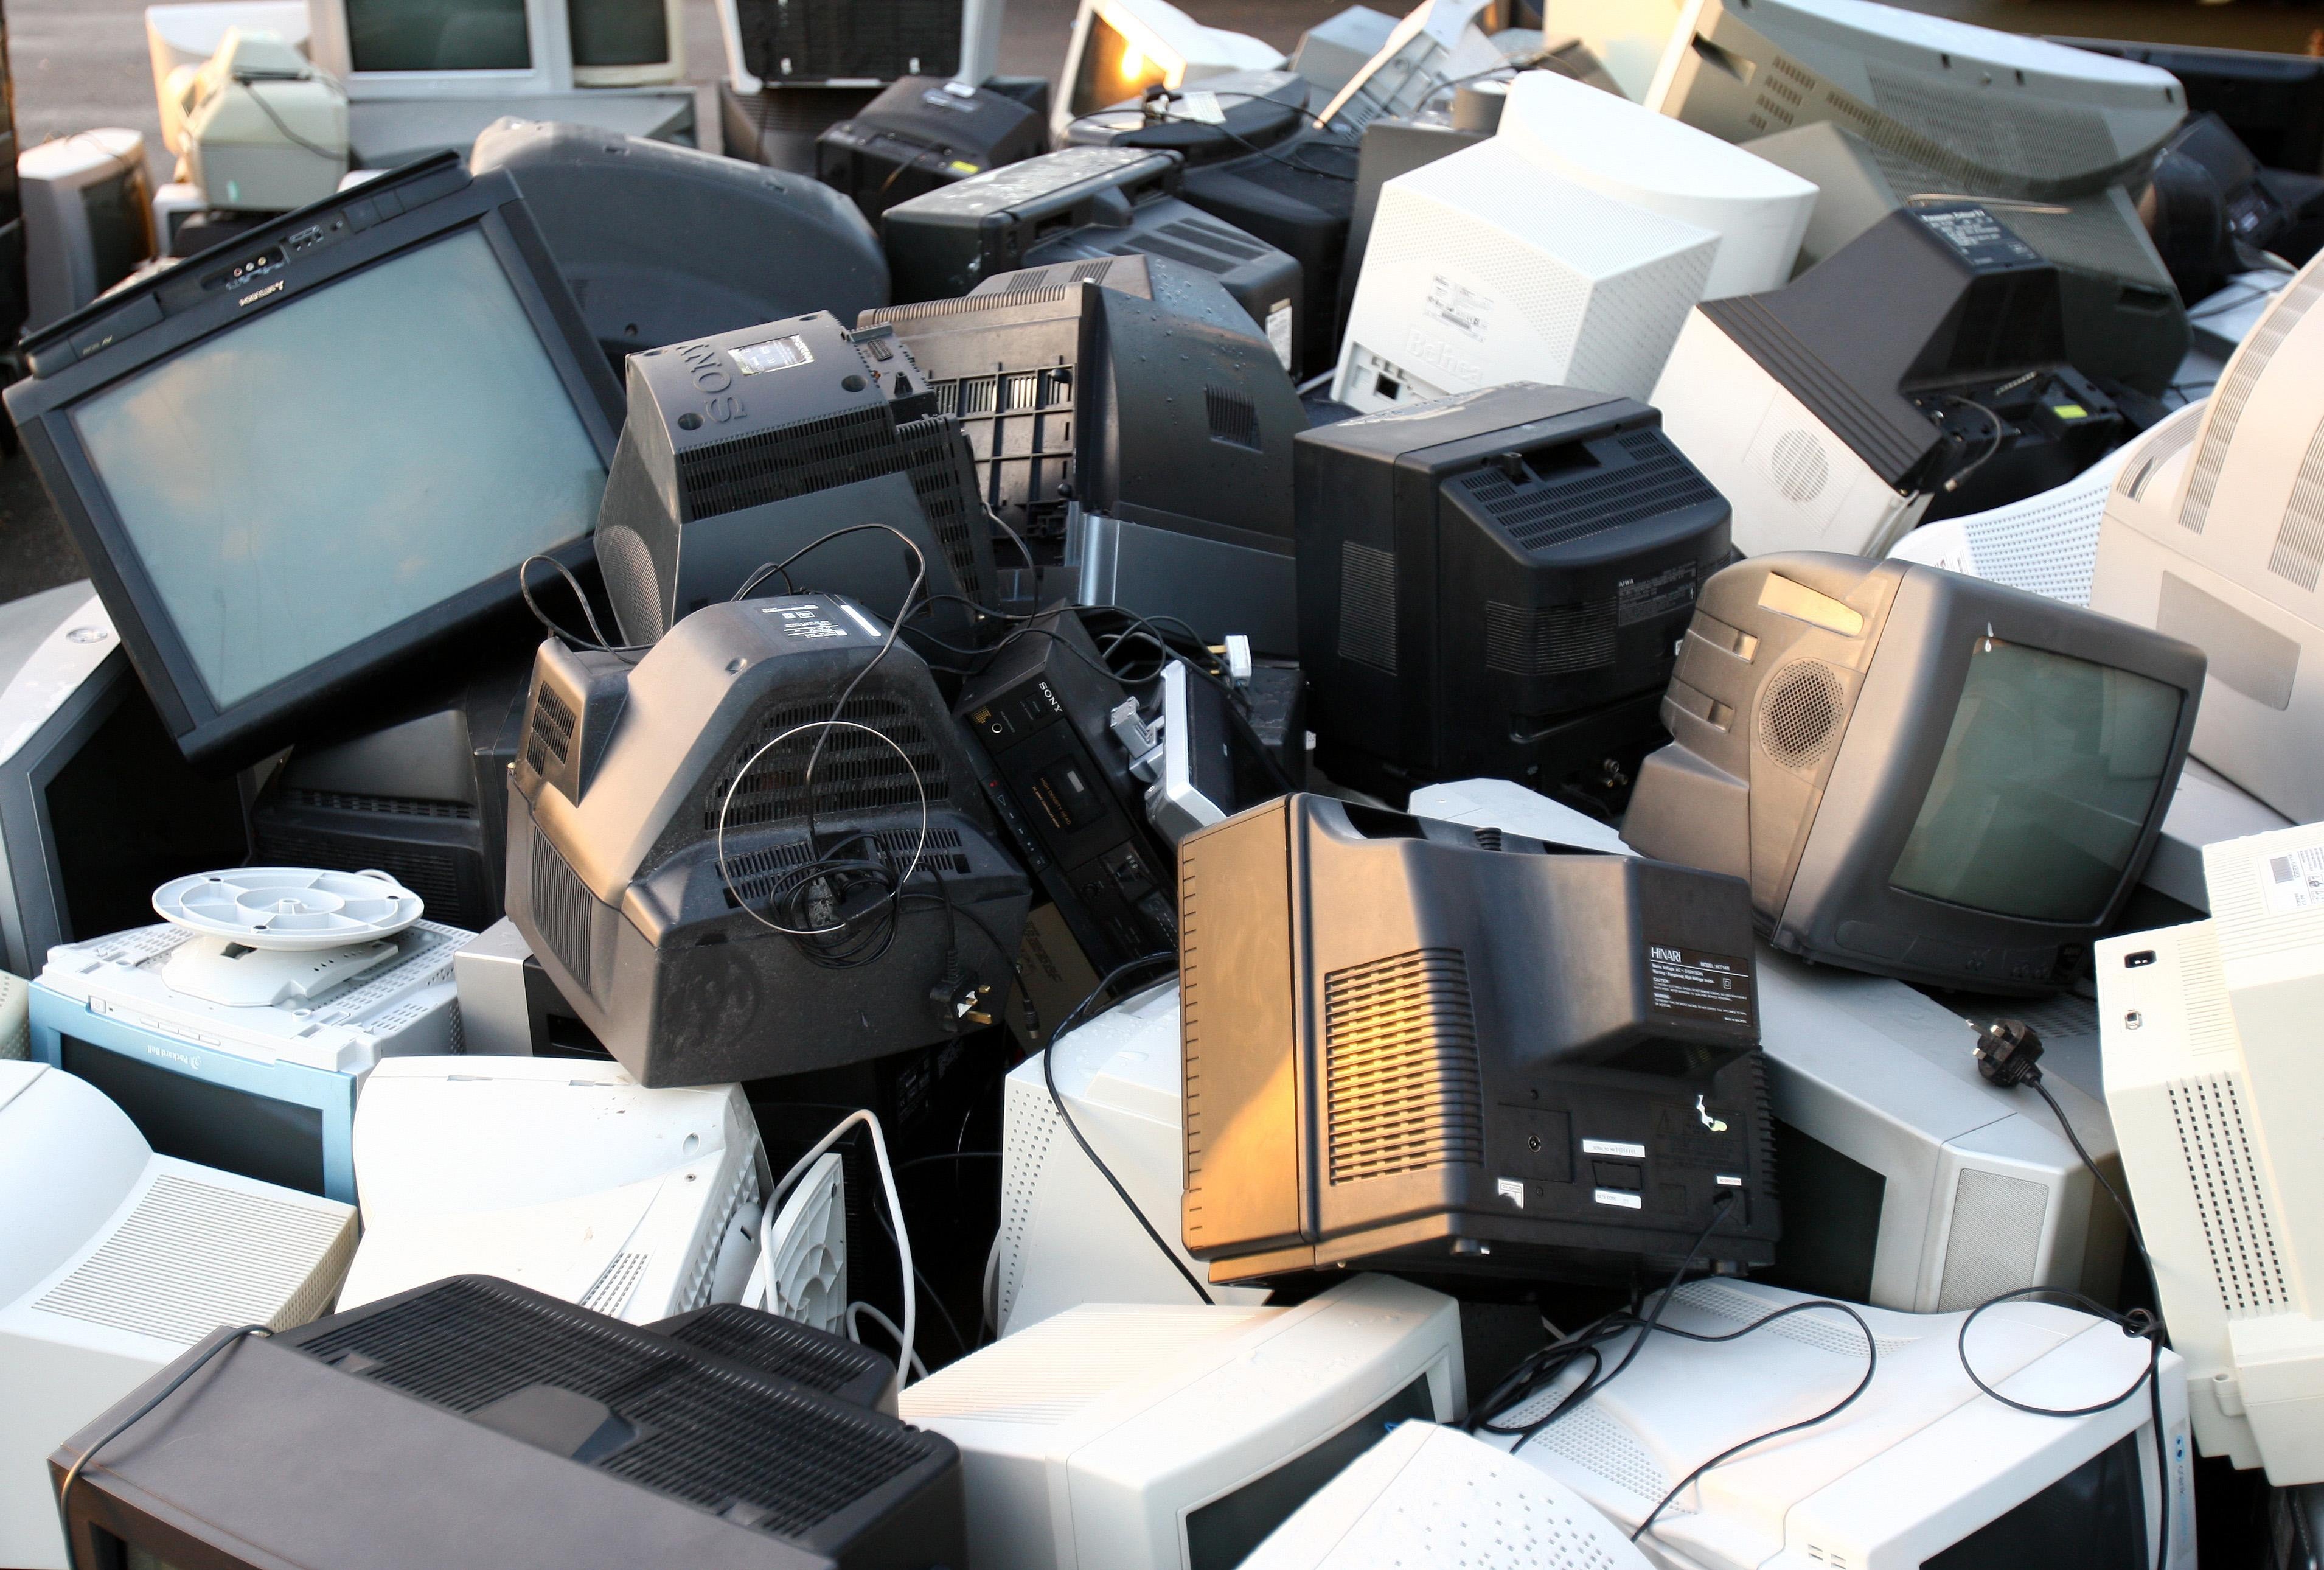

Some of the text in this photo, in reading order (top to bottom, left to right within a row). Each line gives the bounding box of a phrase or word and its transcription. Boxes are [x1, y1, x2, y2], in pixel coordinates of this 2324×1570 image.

[676, 344, 748, 423] SONY
[1619, 578, 1634, 587] AIWA
[1038, 682, 1063, 713] SONY
[147, 1044, 188, 1064] Packard Bell
